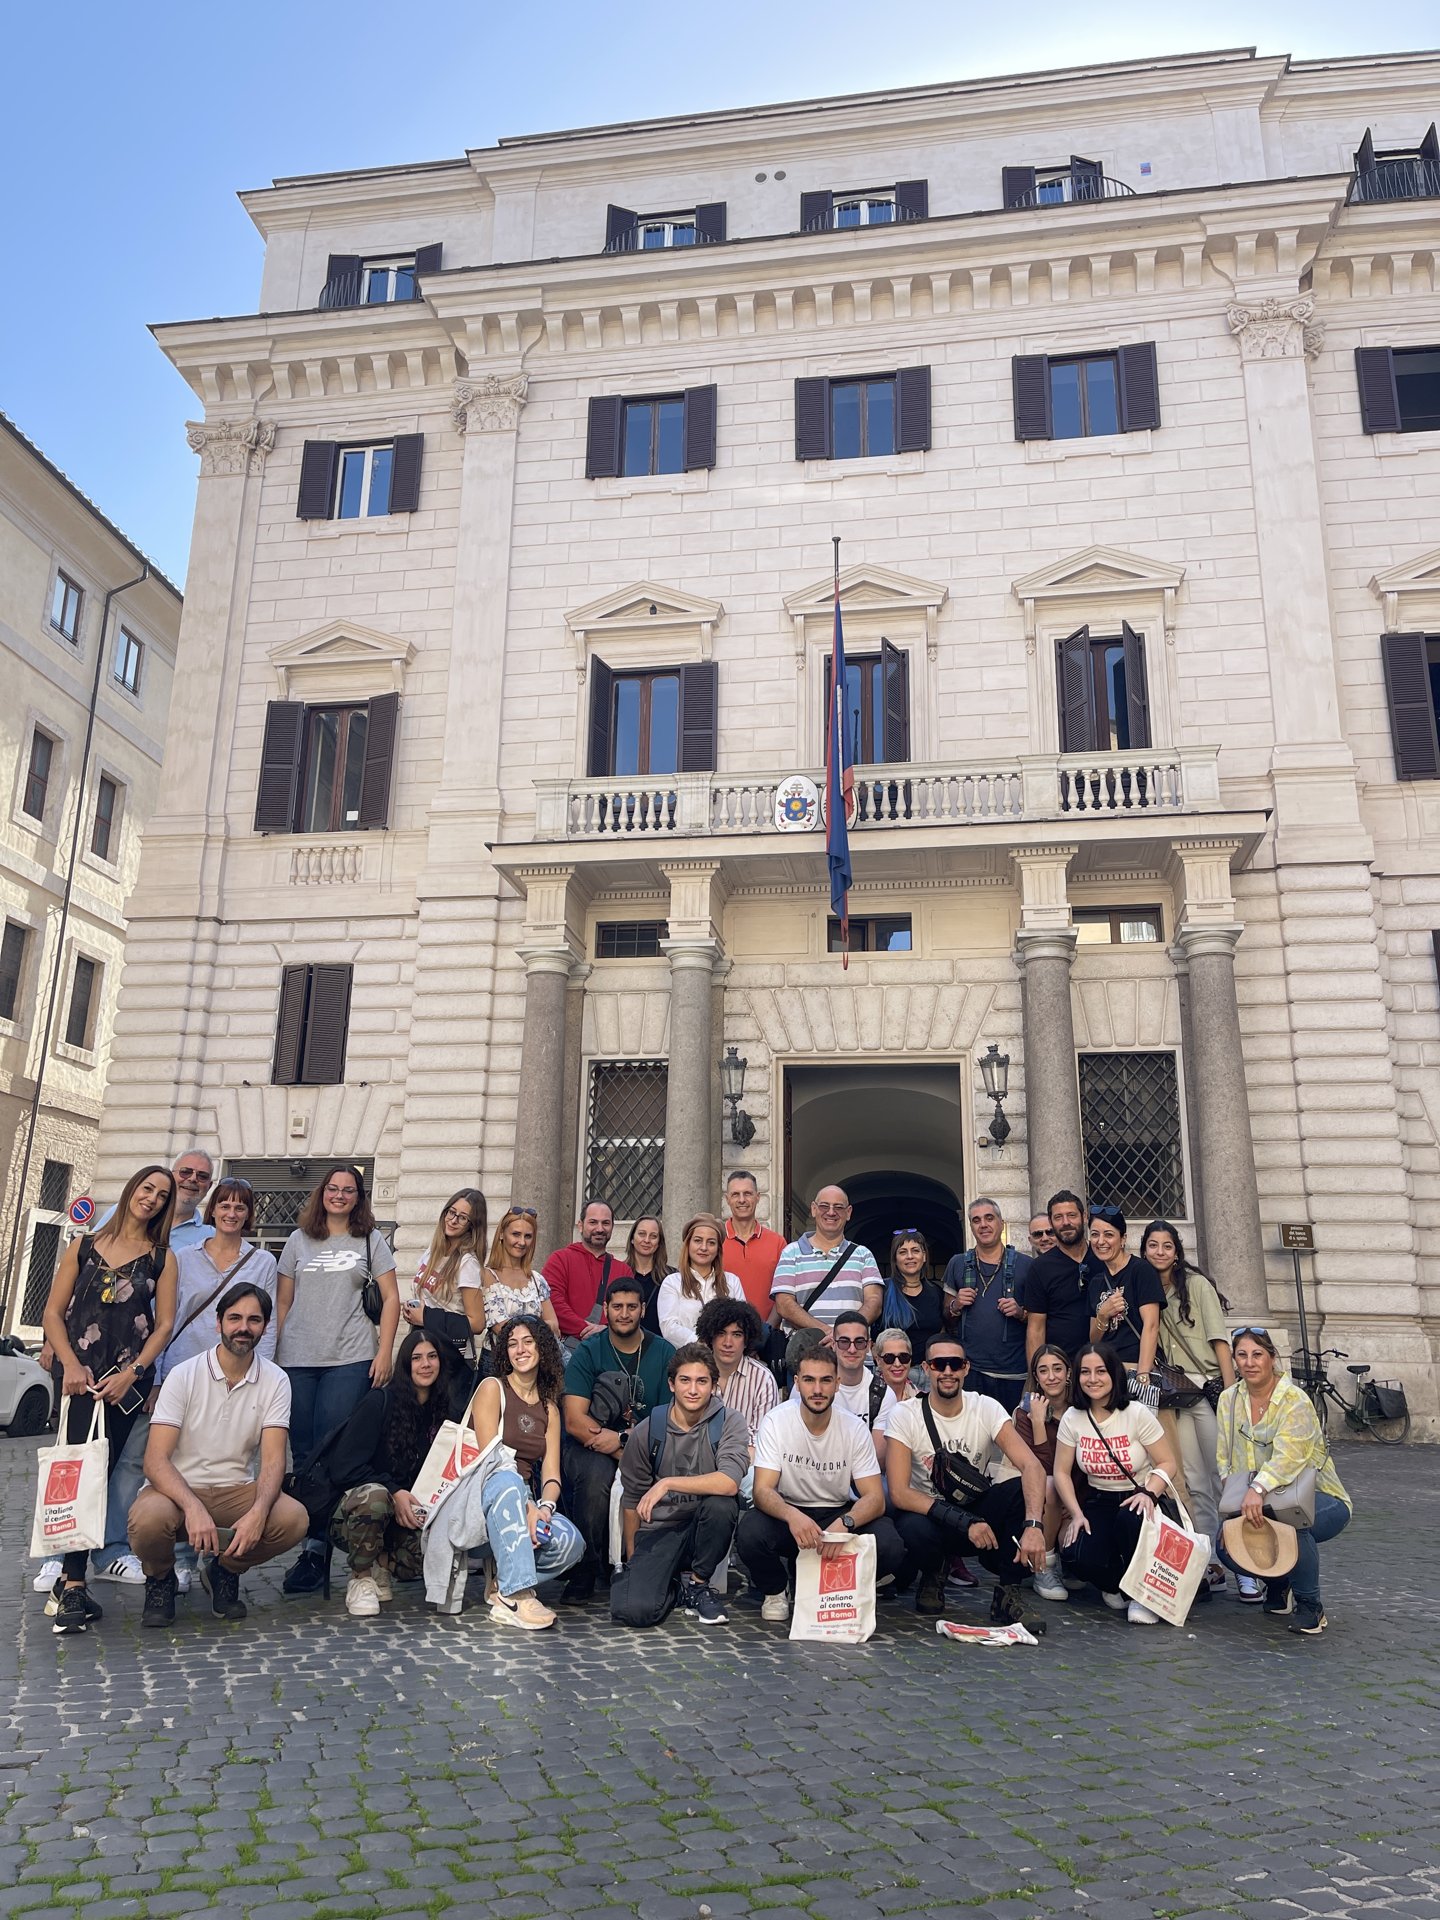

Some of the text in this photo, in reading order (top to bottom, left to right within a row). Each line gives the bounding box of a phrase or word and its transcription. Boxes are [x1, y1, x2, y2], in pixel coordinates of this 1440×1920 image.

[998, 1149, 1004, 1159] 7
[382, 1185, 390, 1196] 6
[1080, 1436, 1106, 1450] STUCK
[1114, 1434, 1131, 1448] THE
[1081, 1450, 1131, 1463] FAIRYLE
[1090, 1464, 1121, 1475] MADE
[45, 1505, 73, 1515] L'italiano
[50, 1513, 74, 1522] centro.
[52, 1521, 74, 1532] Roma)
[1153, 1561, 1179, 1581] L'italiano
[1157, 1573, 1177, 1587] centro.
[1155, 1581, 1175, 1597] Roma)
[821, 1594, 853, 1602] L'italiano
[828, 1601, 854, 1609] centro.
[818, 1610, 855, 1620] (di Roma)
